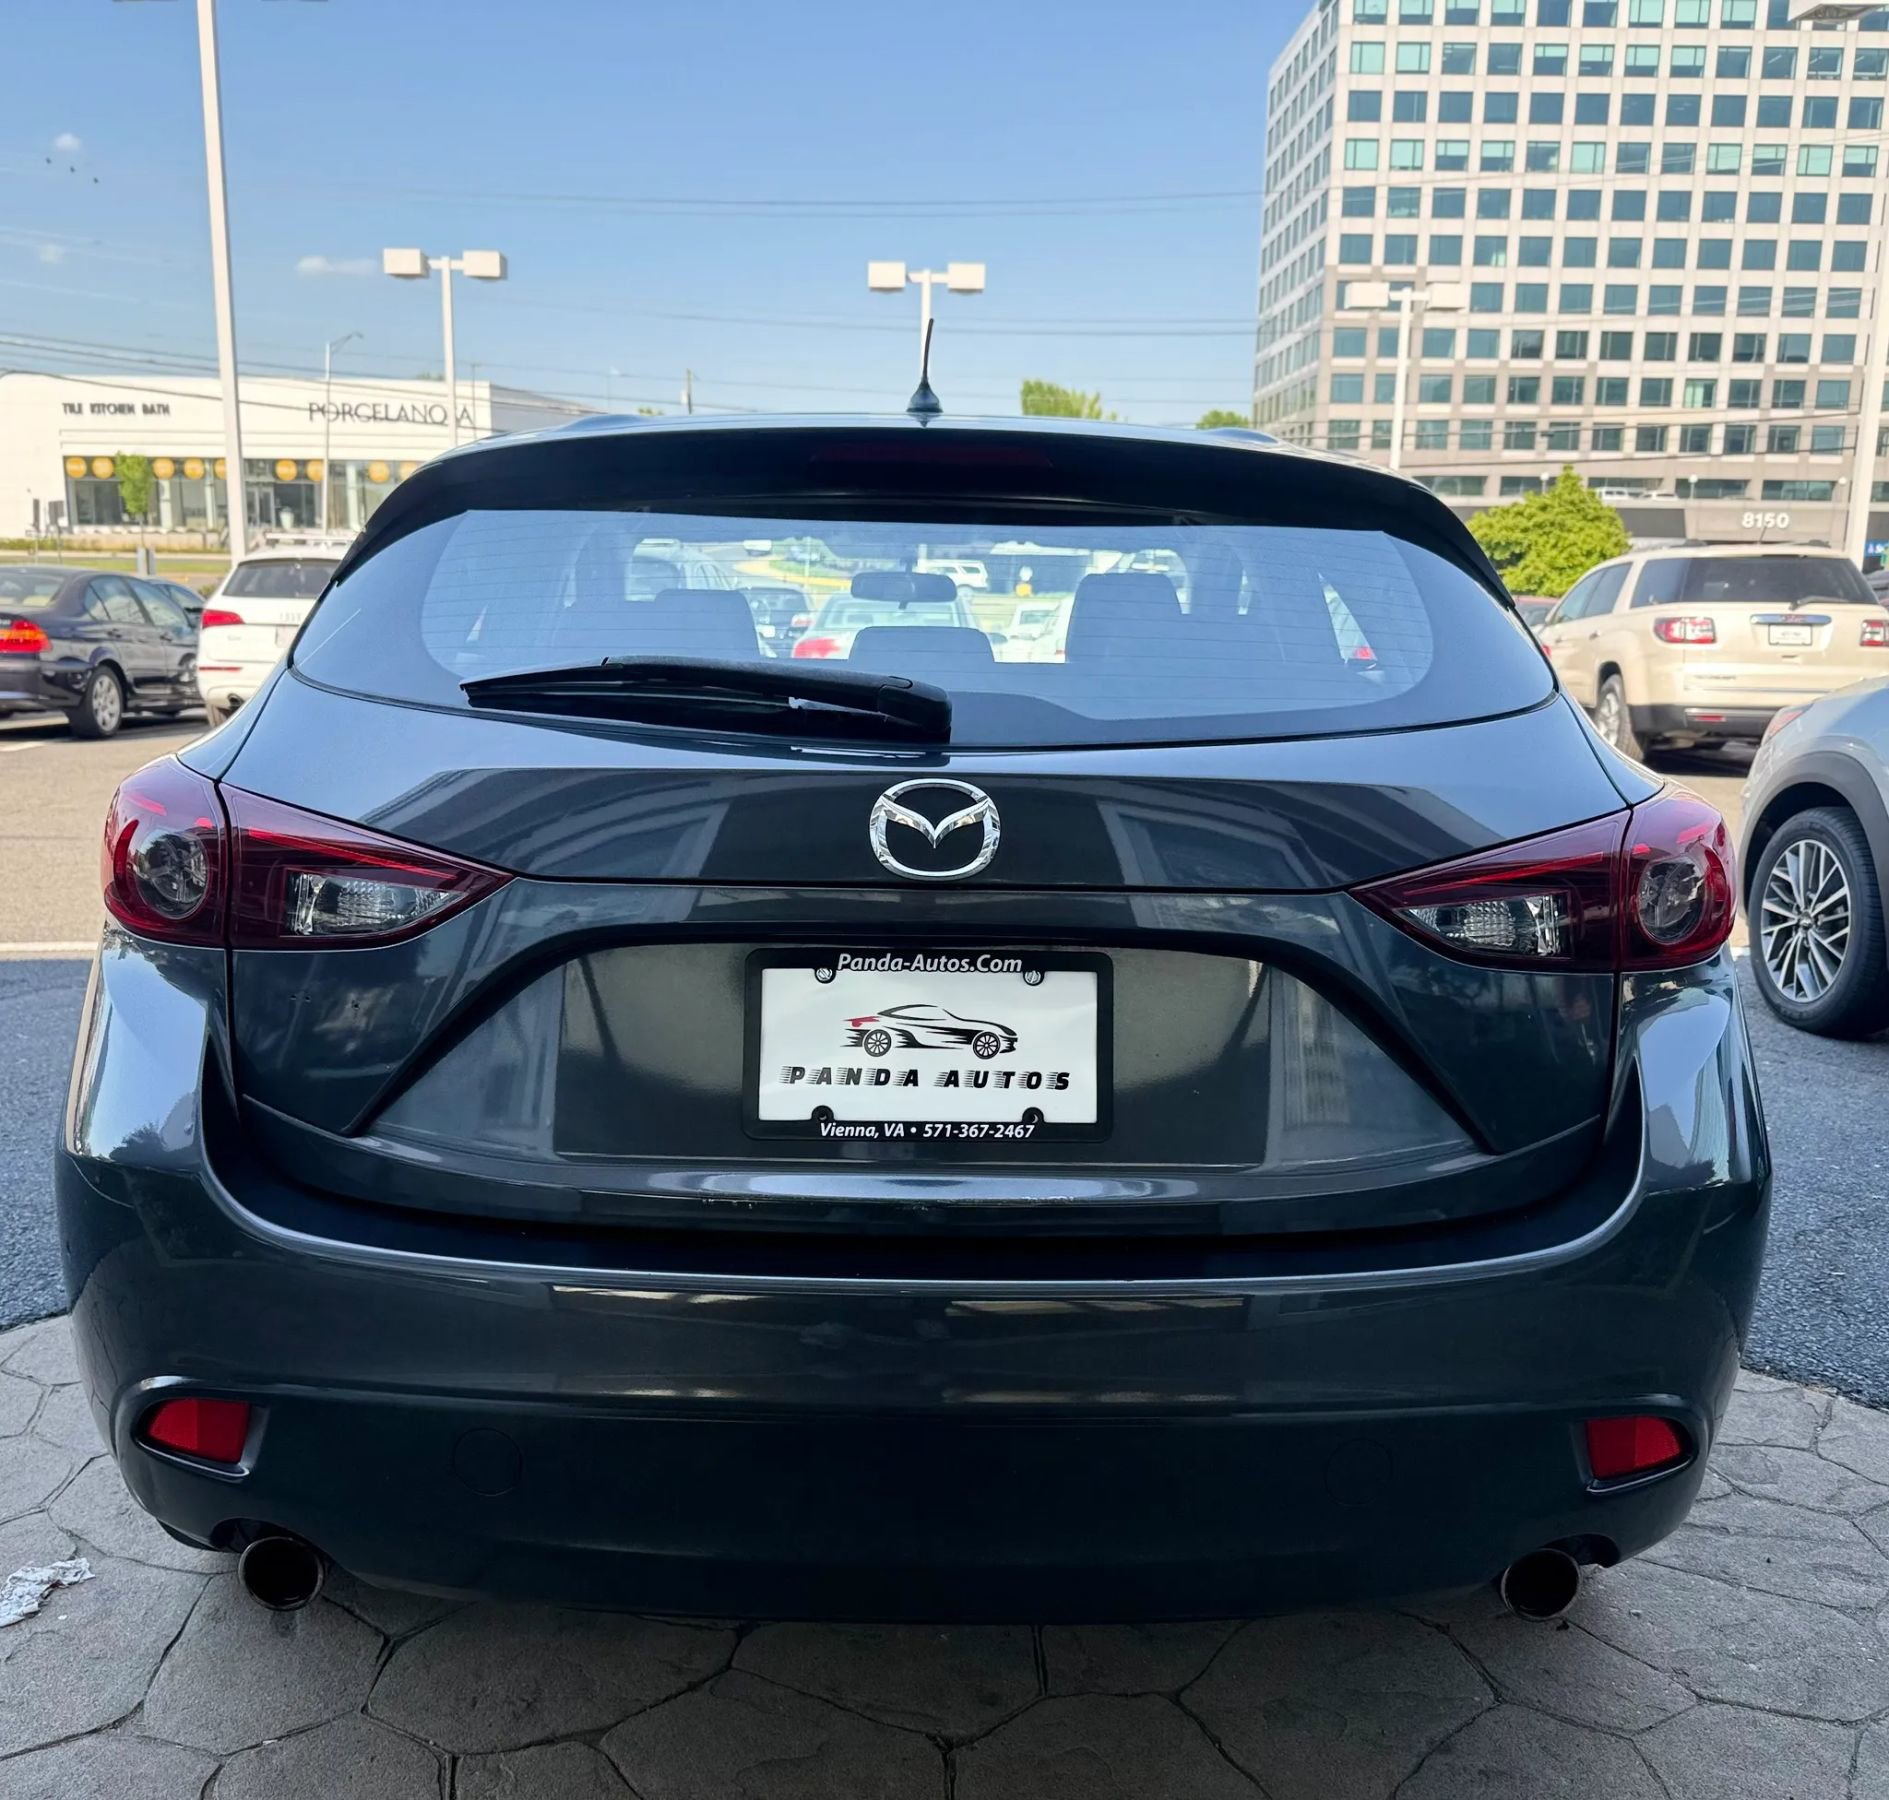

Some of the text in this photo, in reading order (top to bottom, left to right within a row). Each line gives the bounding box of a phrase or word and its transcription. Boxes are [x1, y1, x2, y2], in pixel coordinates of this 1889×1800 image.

[309, 402, 475, 426] PORCELANOA
[1741, 512, 1790, 529] 8150
[837, 953, 1023, 973] Panda-Autos.Com
[779, 1065, 1071, 1091] PANDA AUTOS
[820, 1122, 1035, 1139] Vienna, VA 571-367-2467
